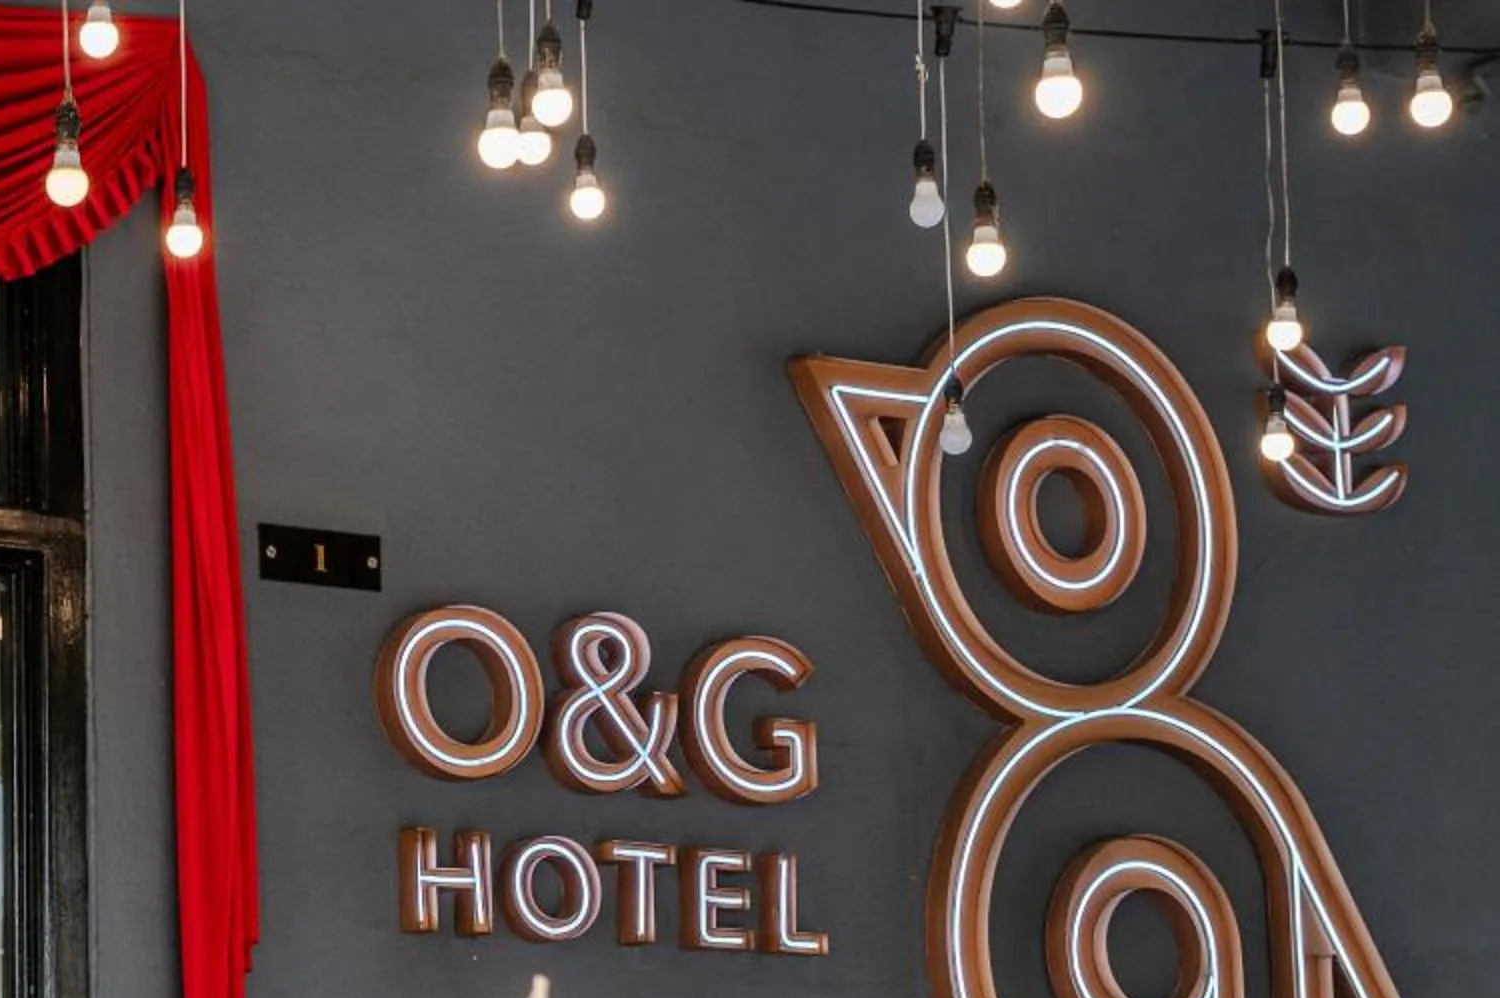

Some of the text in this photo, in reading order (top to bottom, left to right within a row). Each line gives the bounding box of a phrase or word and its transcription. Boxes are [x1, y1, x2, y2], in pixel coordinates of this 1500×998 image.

[313, 543, 328, 573] 1
[376, 604, 819, 805] O&G
[401, 826, 828, 955] HOTEL
